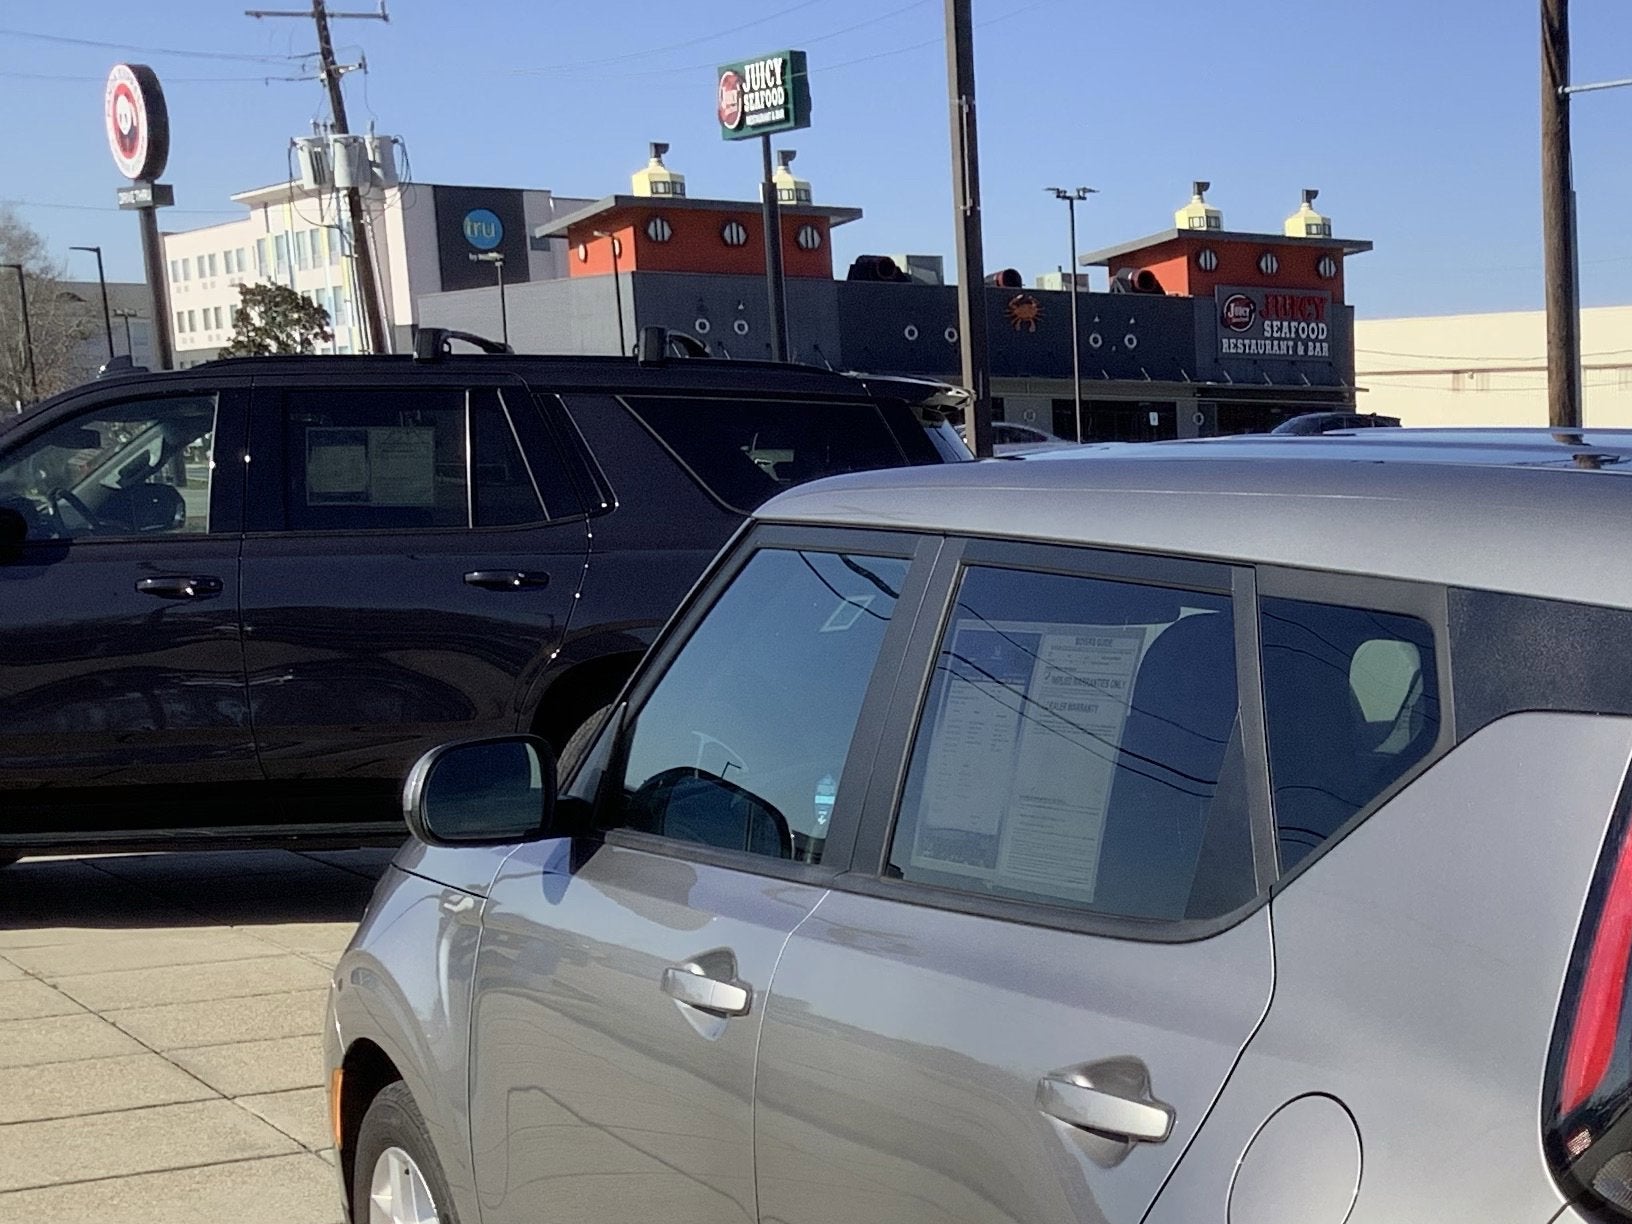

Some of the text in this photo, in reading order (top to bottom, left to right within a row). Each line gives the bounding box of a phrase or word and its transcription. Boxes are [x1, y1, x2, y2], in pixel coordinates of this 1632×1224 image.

[742, 57, 783, 93] JUICY
[743, 86, 785, 113] SEAFOOD
[1260, 295, 1328, 321] JUICY
[1263, 320, 1328, 340] SEAFOOD
[1221, 338, 1329, 357] RESTAURANT & BAR
